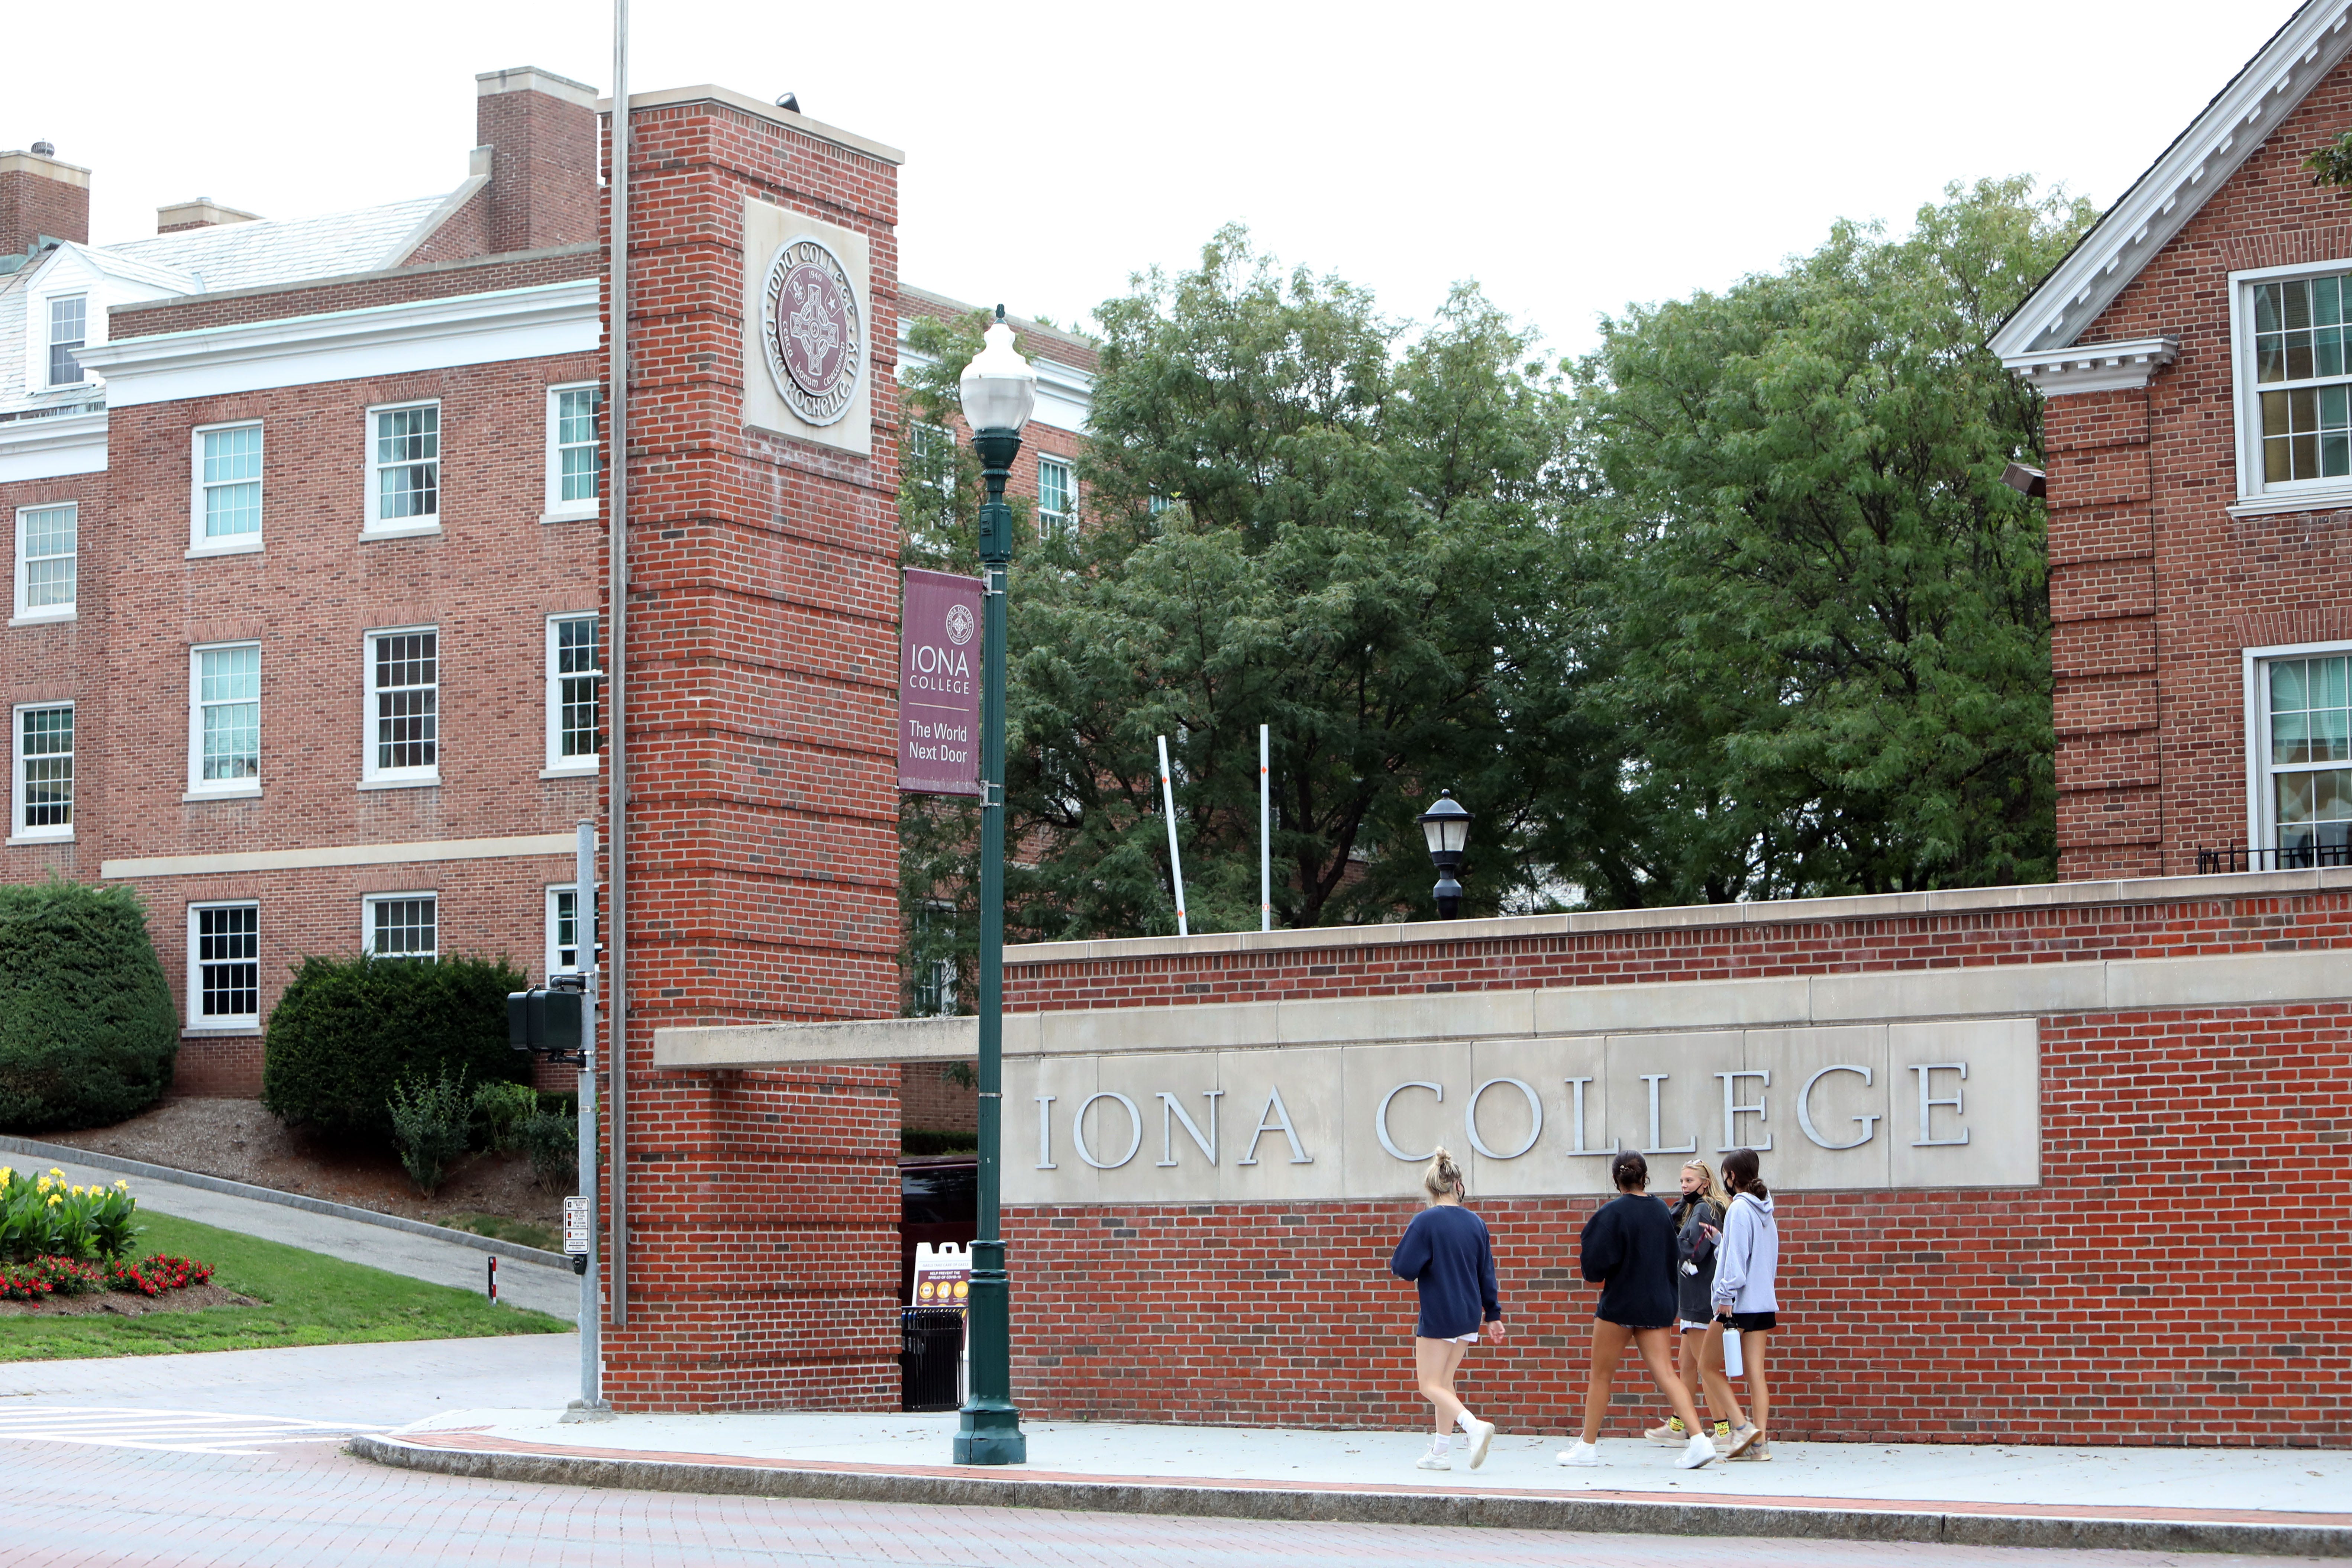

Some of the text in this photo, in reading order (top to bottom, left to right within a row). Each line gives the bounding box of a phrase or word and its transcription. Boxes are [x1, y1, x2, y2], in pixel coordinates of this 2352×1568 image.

[808, 270, 822, 282] 1940
[782, 320, 846, 388] certa bonum certamen
[948, 608, 957, 621] IONA
[911, 644, 970, 678] IONA
[910, 675, 969, 695] COLLEGE
[909, 720, 967, 742] The World
[909, 741, 967, 763] Next Door
[1034, 1062, 1970, 1169] IONA COLLEGE
